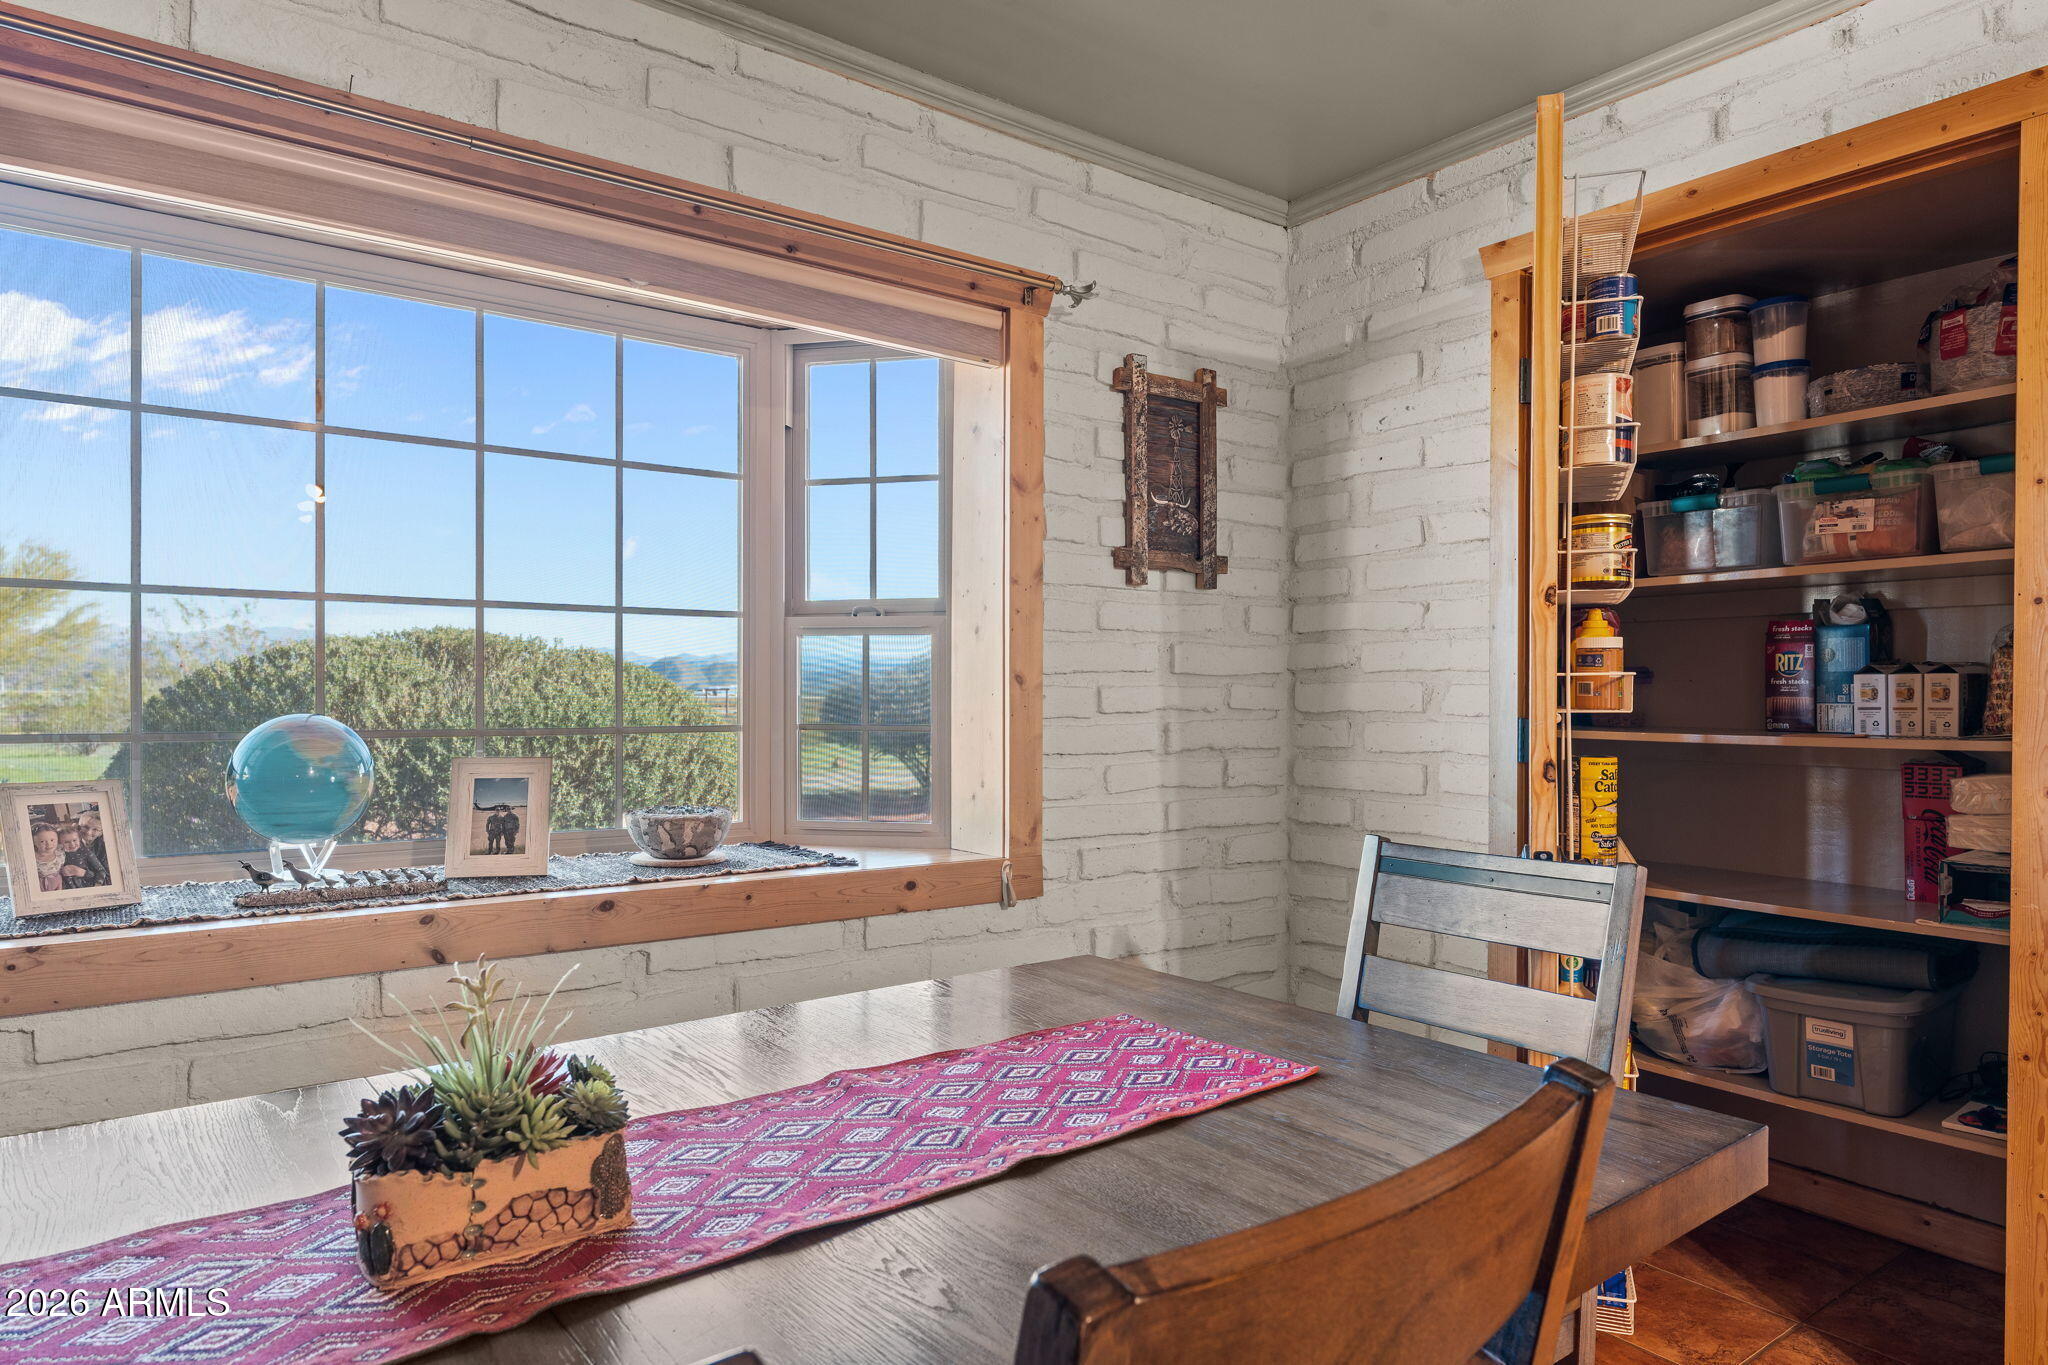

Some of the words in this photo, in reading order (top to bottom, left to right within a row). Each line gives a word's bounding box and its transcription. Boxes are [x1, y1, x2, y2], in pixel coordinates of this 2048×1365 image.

[1775, 653, 1804, 672] RITZ
[1904, 767, 1914, 798] mini
[1918, 767, 1928, 799] mini
[1807, 1044, 1836, 1055] Storage
